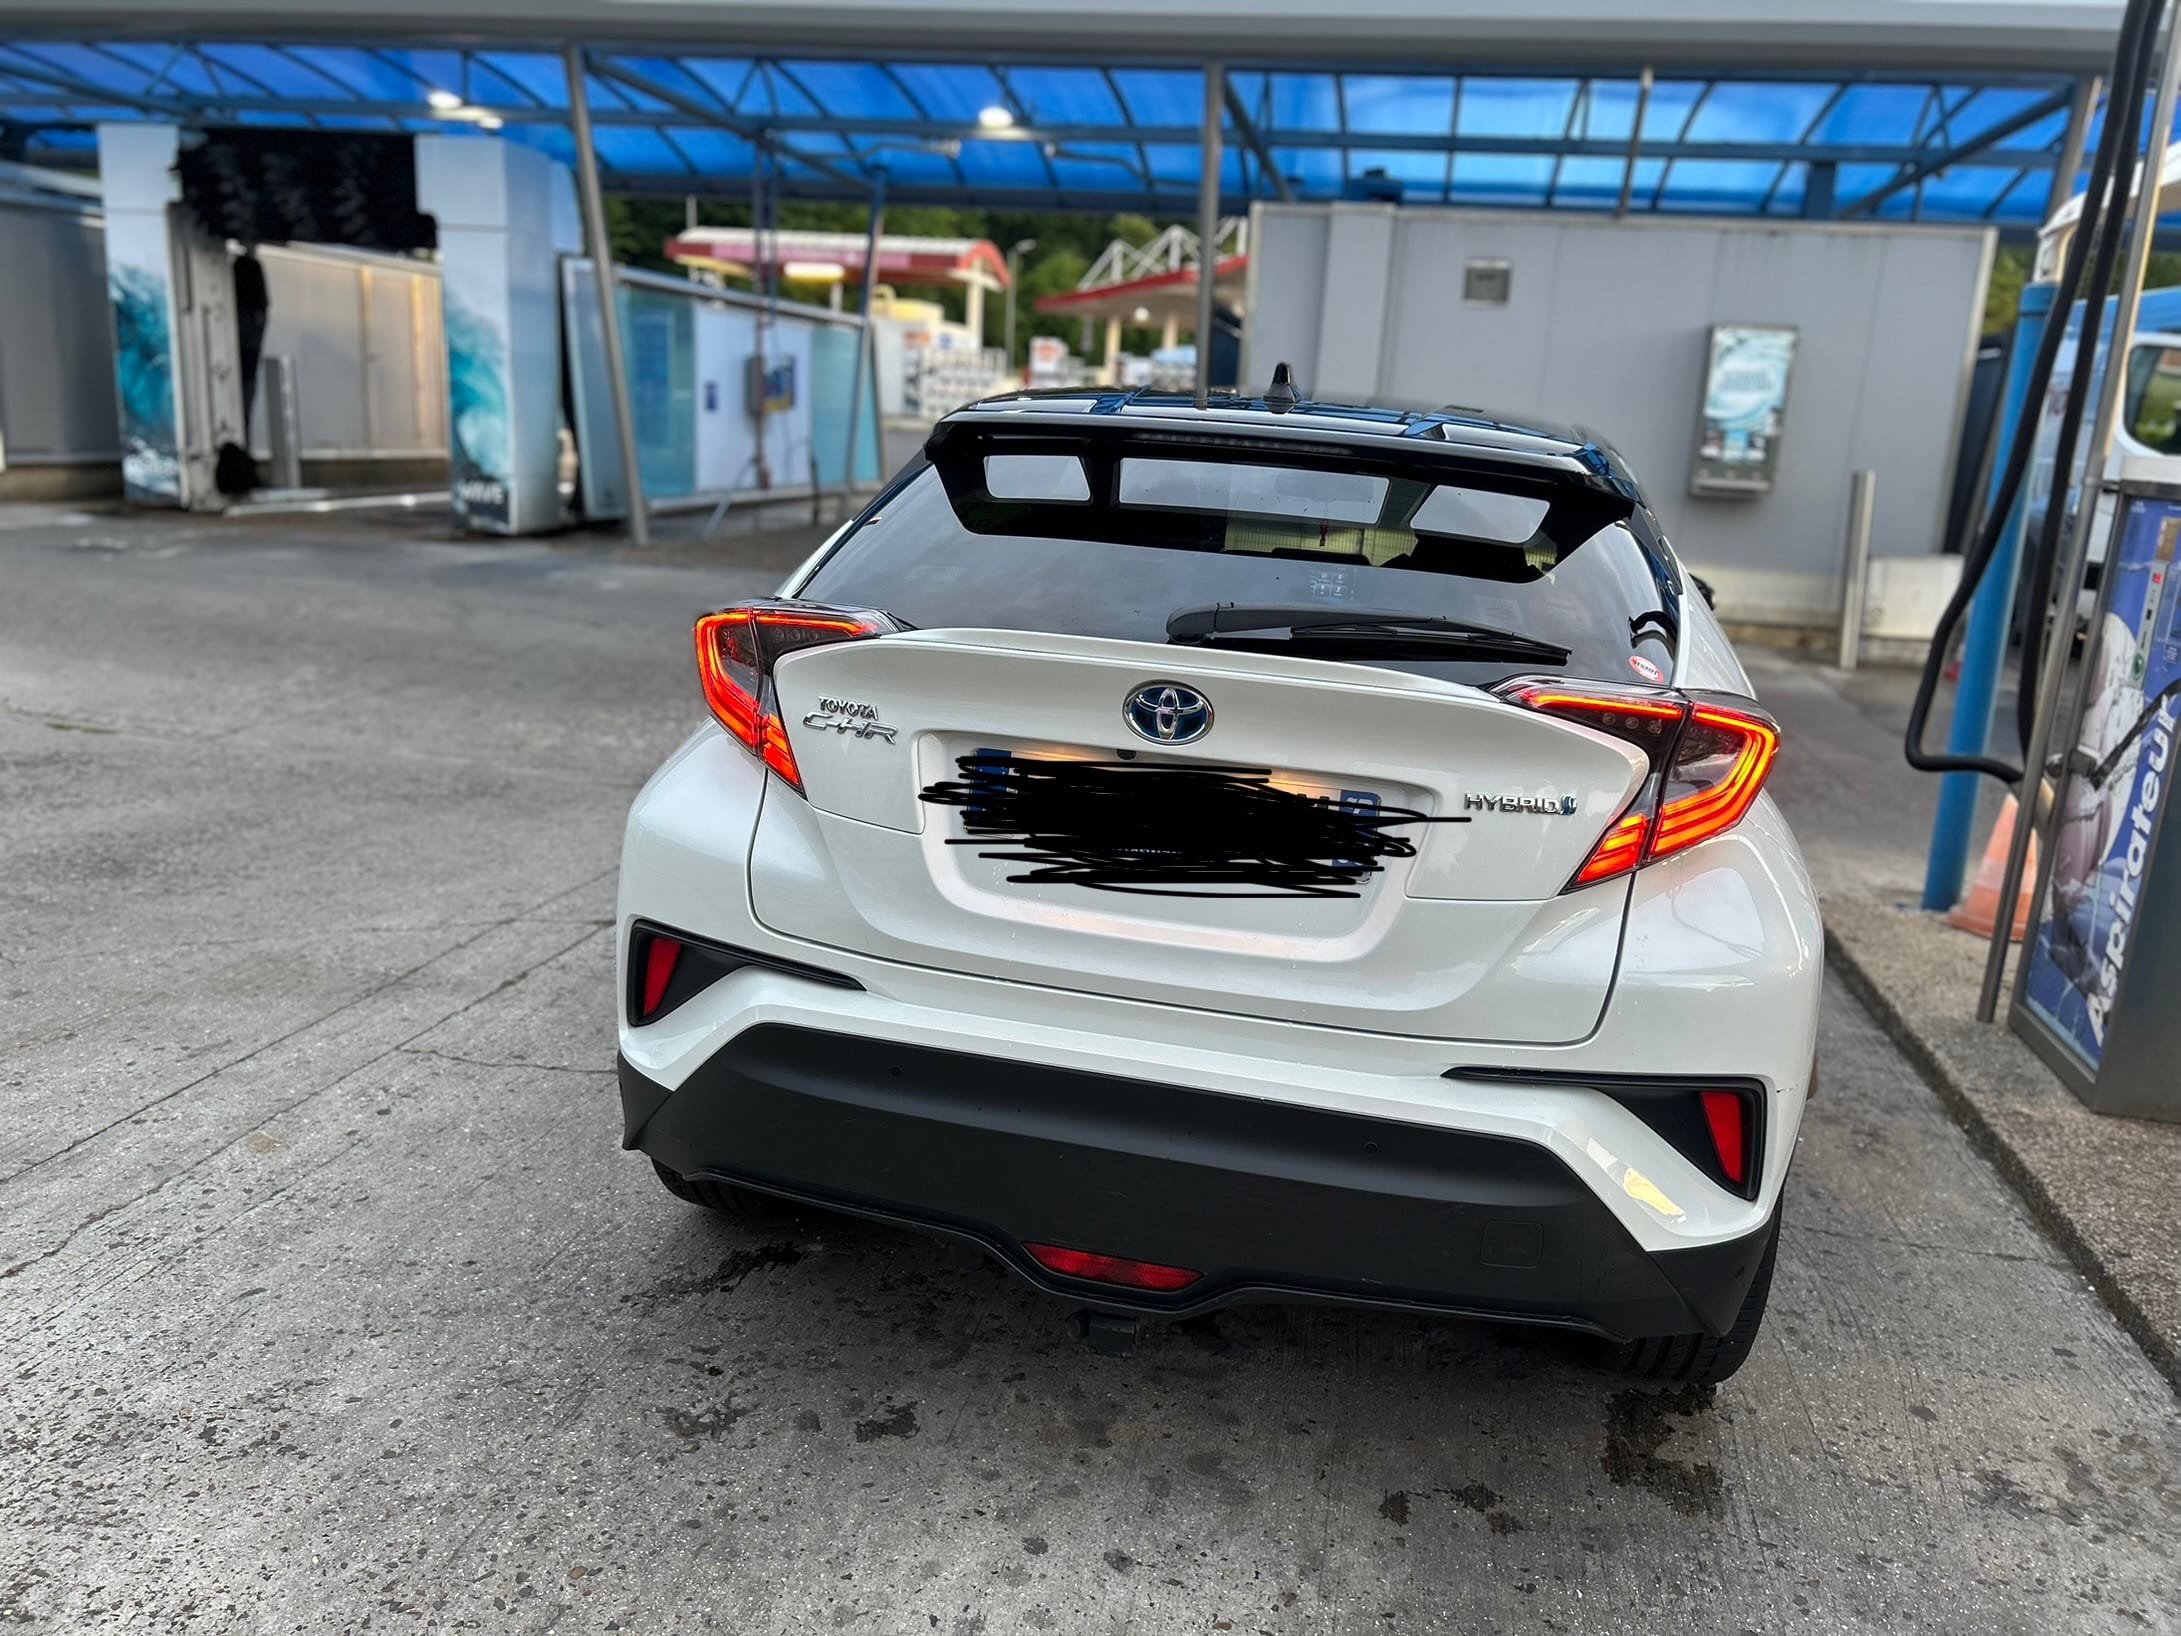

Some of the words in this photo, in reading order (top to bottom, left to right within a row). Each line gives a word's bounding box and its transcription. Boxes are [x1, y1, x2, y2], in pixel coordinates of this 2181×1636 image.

[818, 696, 879, 721] TOYOTA
[1463, 793, 1562, 815] HYBRID
[2086, 693, 2176, 1048] Aspirateur
